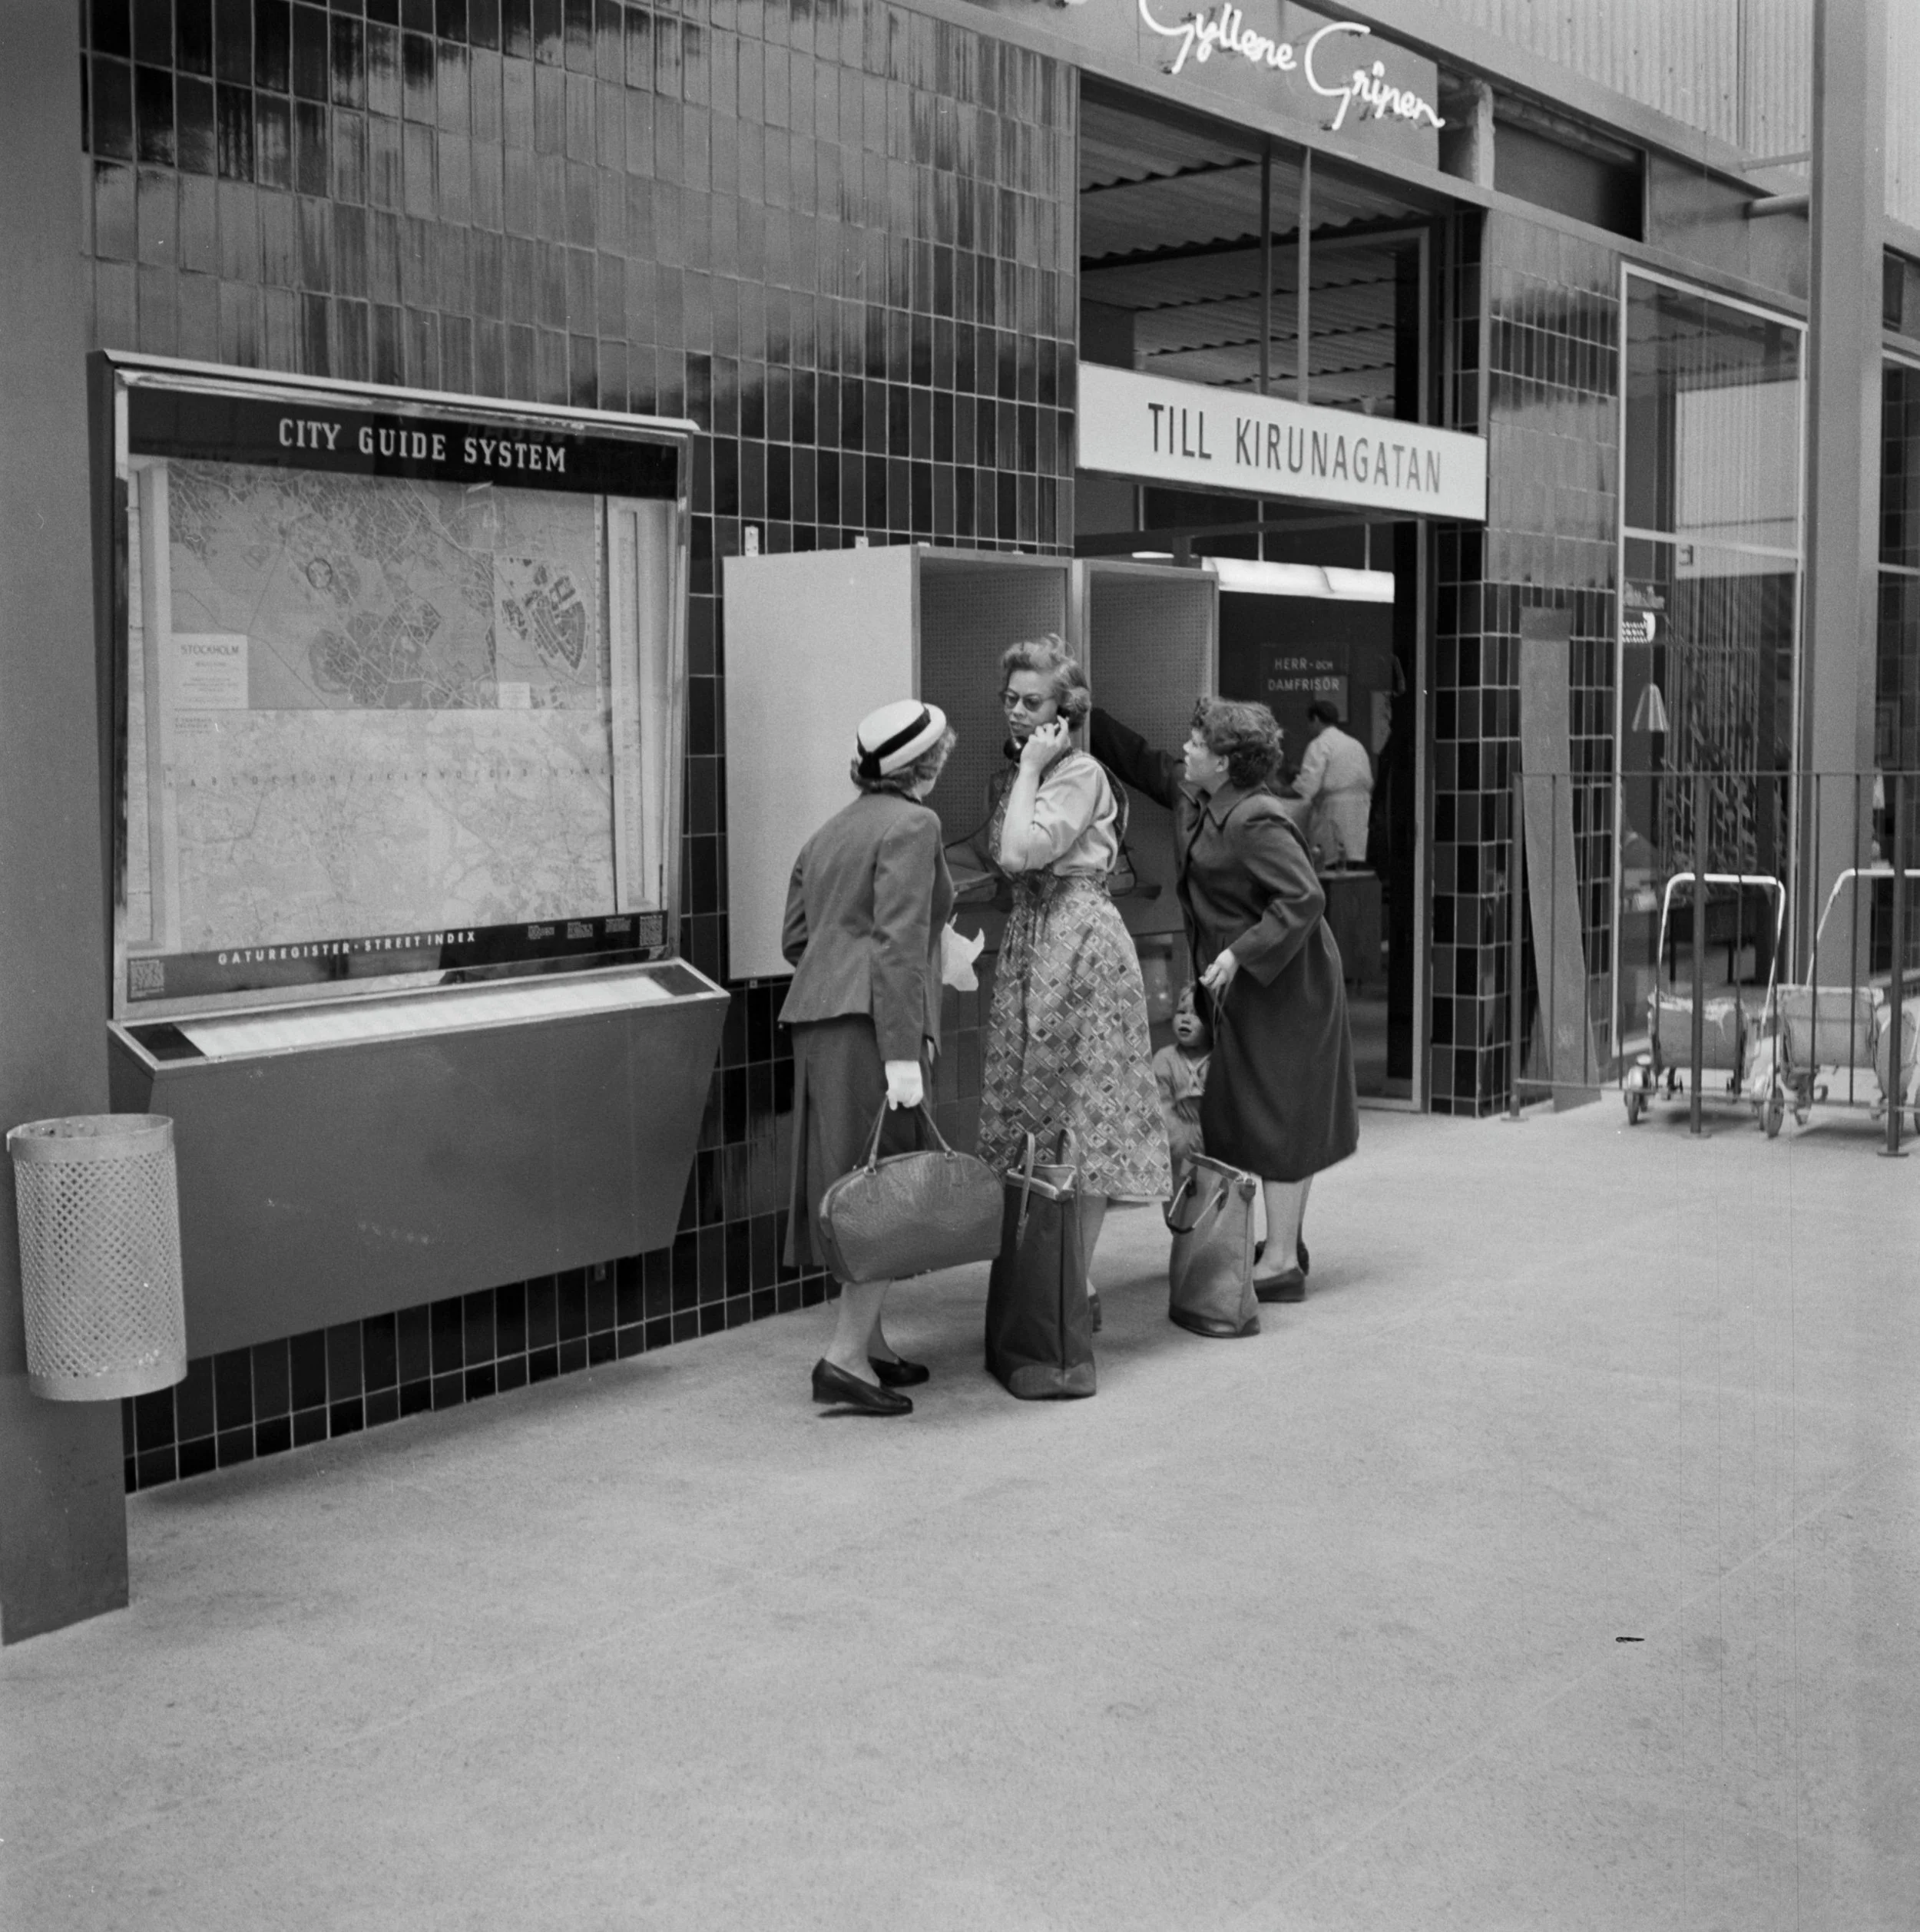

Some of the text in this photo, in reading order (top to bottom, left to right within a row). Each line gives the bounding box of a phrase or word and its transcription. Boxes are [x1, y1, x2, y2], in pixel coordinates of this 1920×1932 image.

[1304, 22, 1446, 131] Gripen
[279, 418, 340, 449] CITY
[359, 427, 445, 461] GUIDE
[464, 437, 566, 473] SYSTEM
[1147, 402, 1442, 494] TILL KIRUNAGATAN
[180, 643, 239, 656] STOCKHOLM
[1267, 677, 1340, 691] DAMFRISÖR
[217, 931, 476, 965] GATUREGISTER STREET INDEX
